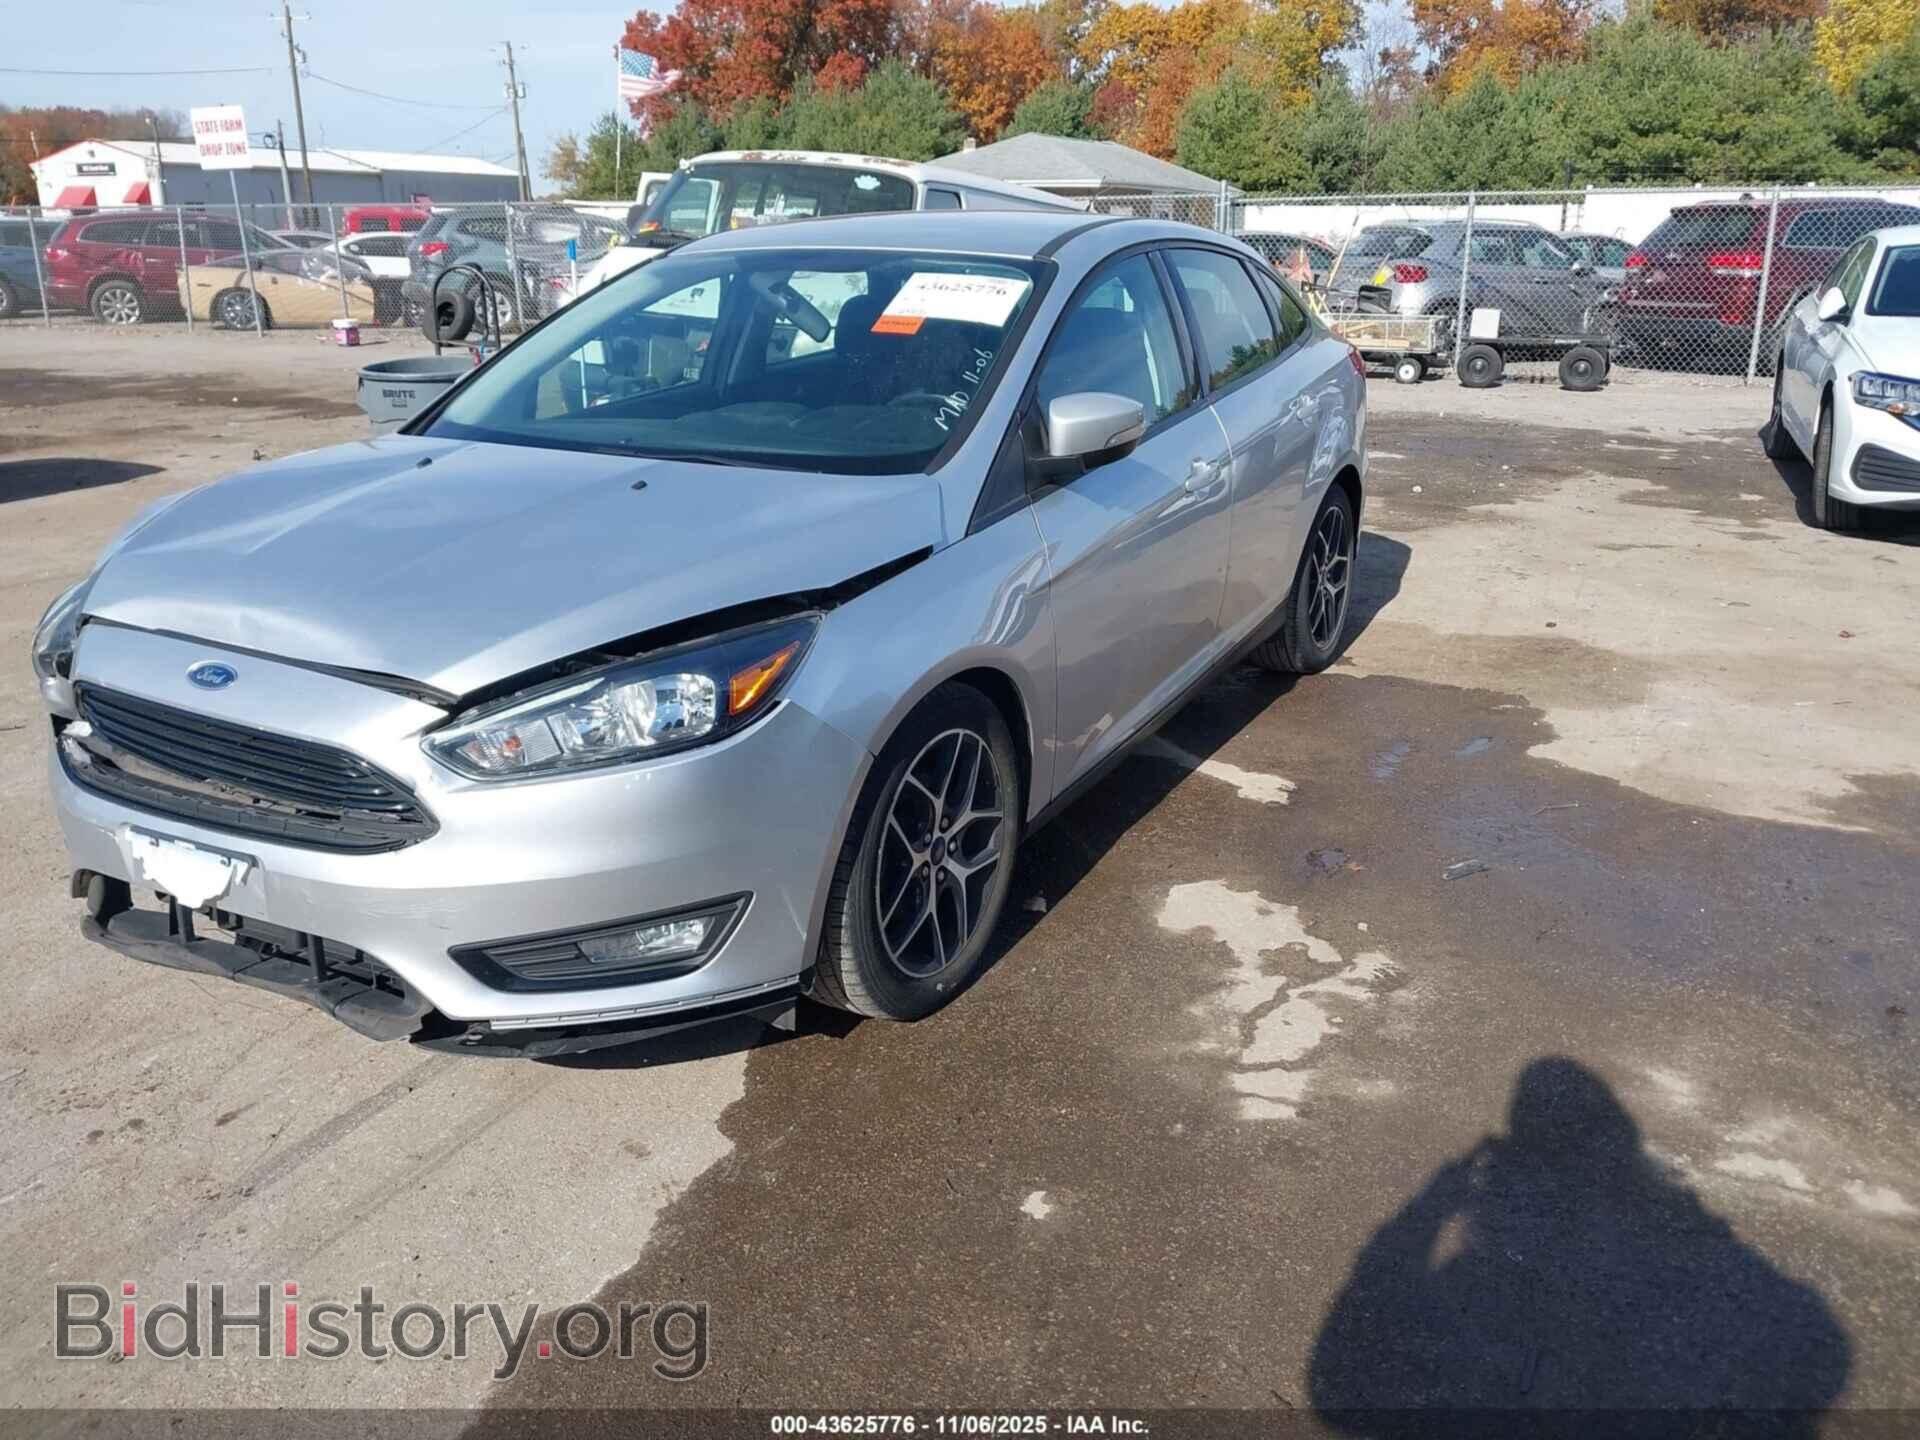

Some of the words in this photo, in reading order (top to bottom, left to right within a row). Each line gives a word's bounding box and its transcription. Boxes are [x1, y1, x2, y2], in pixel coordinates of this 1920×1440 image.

[195, 120, 219, 134] STATE
[220, 119, 243, 132] FARM
[200, 143, 223, 156] DROP
[226, 141, 247, 155] ZONE
[382, 389, 416, 399] BRUTE
[196, 668, 227, 684] Ford
